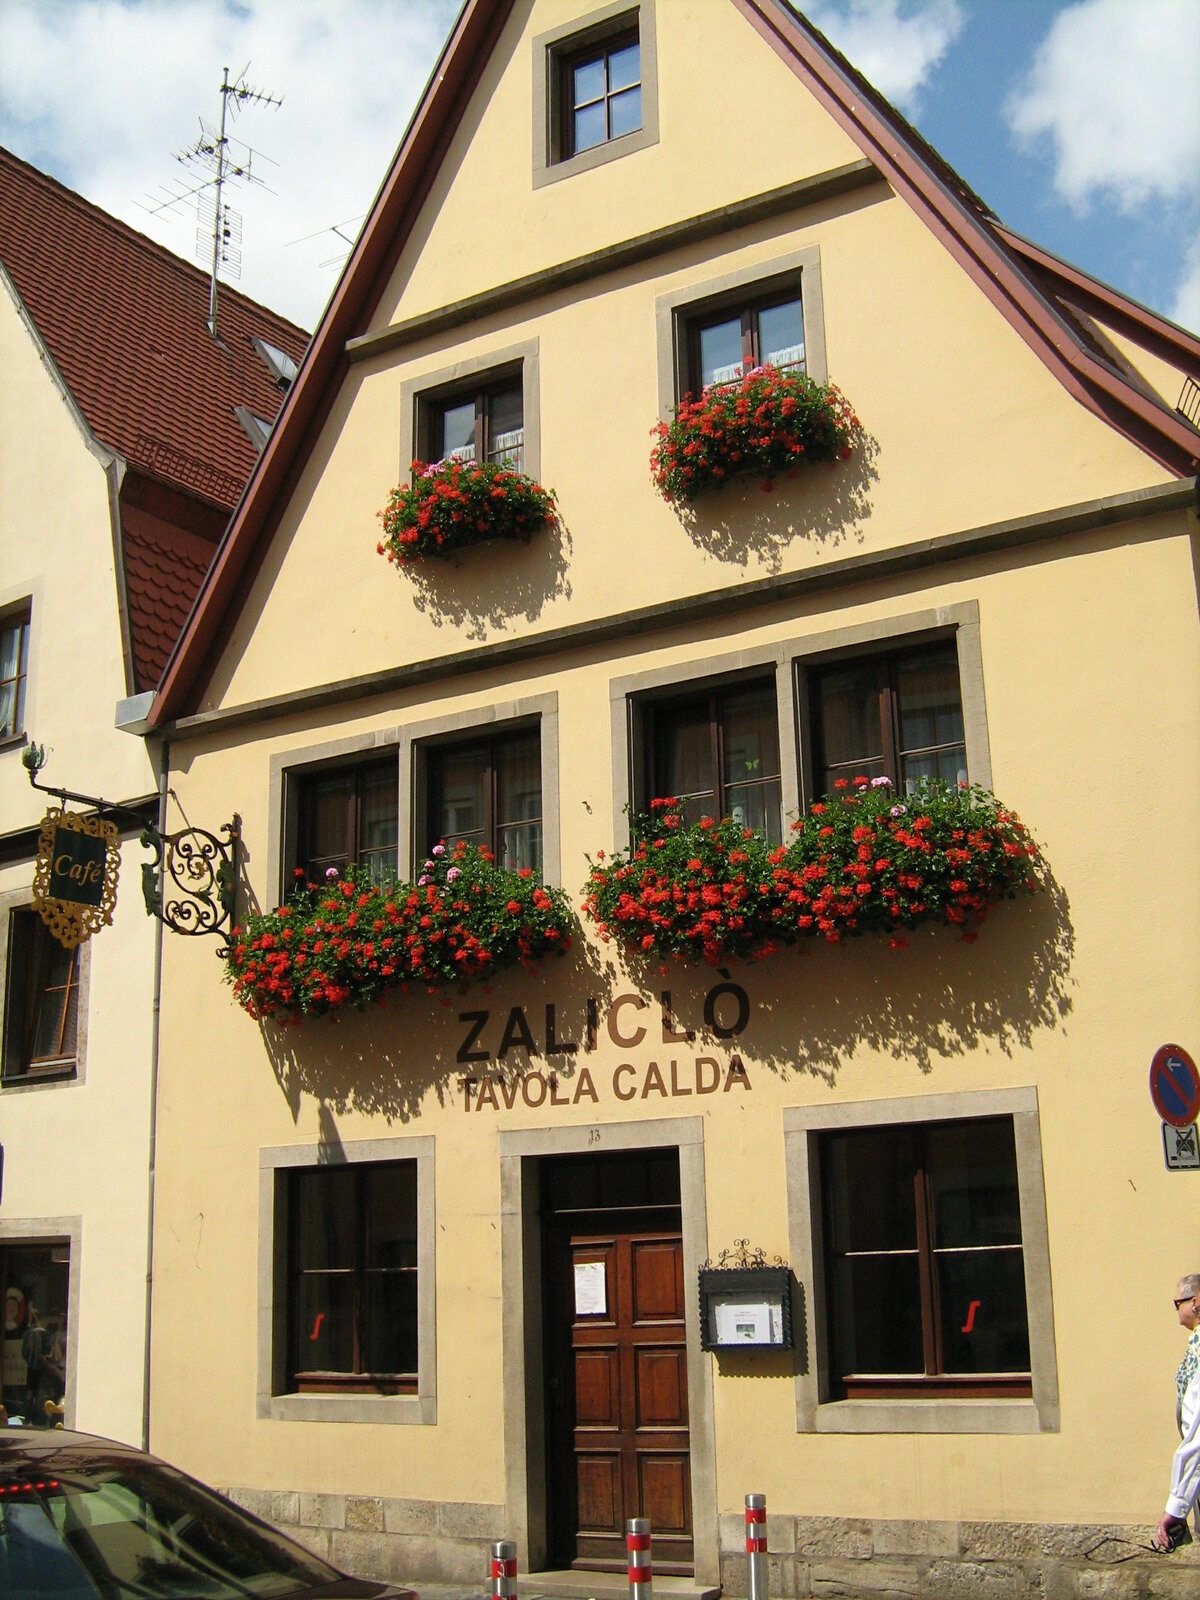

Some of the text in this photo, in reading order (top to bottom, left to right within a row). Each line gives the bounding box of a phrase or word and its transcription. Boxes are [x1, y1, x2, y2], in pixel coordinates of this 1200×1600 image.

[54, 855, 102, 886] Café
[457, 1054, 752, 1113] TAVOLA CALDA
